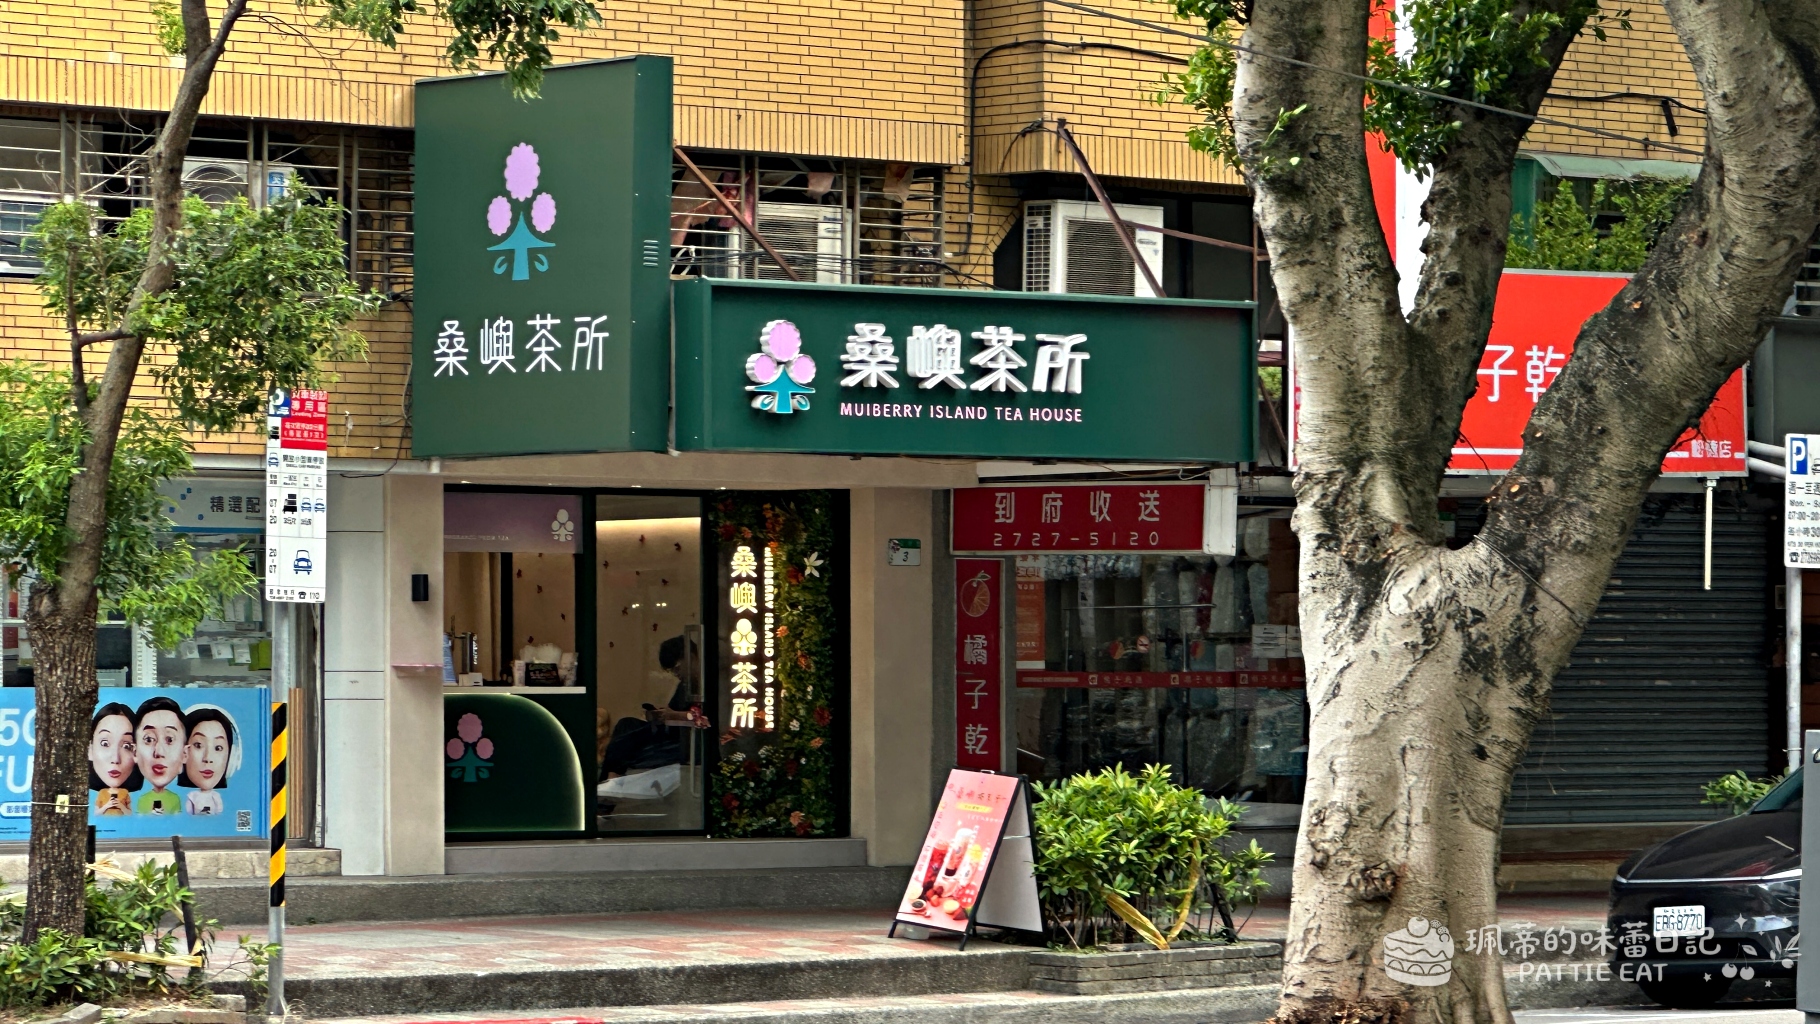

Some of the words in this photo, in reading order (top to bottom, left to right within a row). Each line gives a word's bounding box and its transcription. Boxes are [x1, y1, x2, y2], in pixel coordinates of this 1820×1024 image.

[433, 313, 610, 378] 桑嶼茶所
[839, 322, 1091, 394] 桑嶼茶所
[839, 402, 923, 418] MUIBERRY
[929, 404, 988, 420] ISLAND
[994, 406, 1024, 421] TEA
[1029, 407, 1083, 423] HOUSE
[994, 489, 1161, 524] 到府收送
[993, 531, 1160, 547] 2727-5120
[764, 612, 774, 658] ISLAND
[764, 660, 774, 684] TEA
[963, 634, 989, 755] 橘子乾
